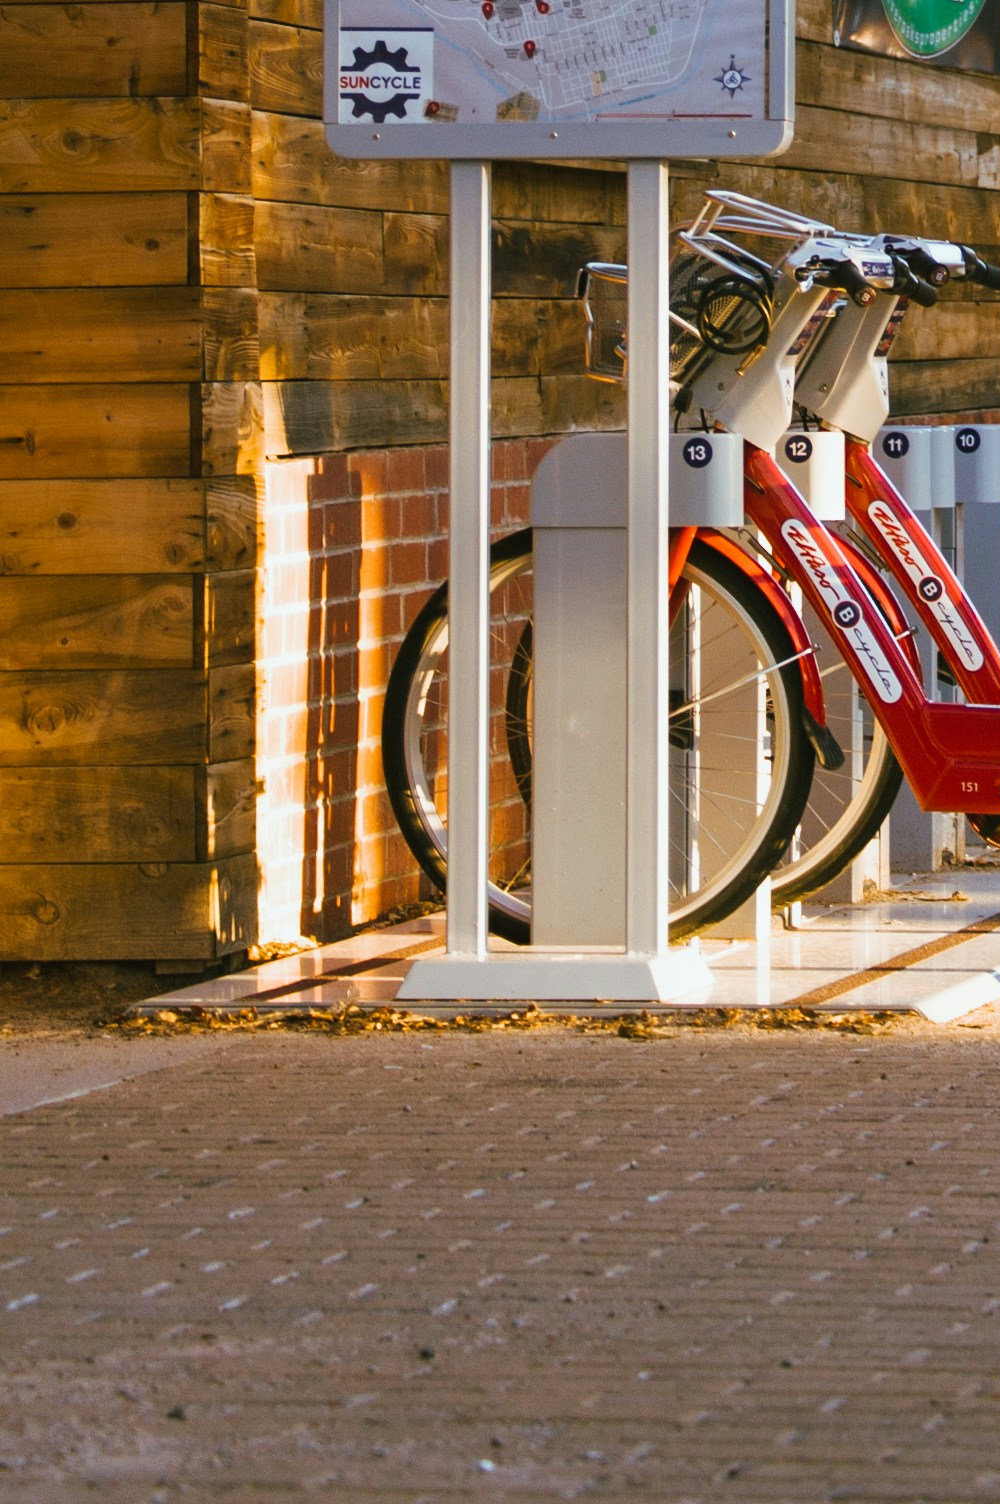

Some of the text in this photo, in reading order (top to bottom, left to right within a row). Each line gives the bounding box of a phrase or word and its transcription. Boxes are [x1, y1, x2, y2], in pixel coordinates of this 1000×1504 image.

[339, 76, 421, 89] SUNCYCLE
[887, 439, 903, 452] 11
[959, 434, 975, 447] 10
[686, 445, 706, 461] 13
[788, 441, 807, 456] 12
[961, 781, 978, 792] 151
